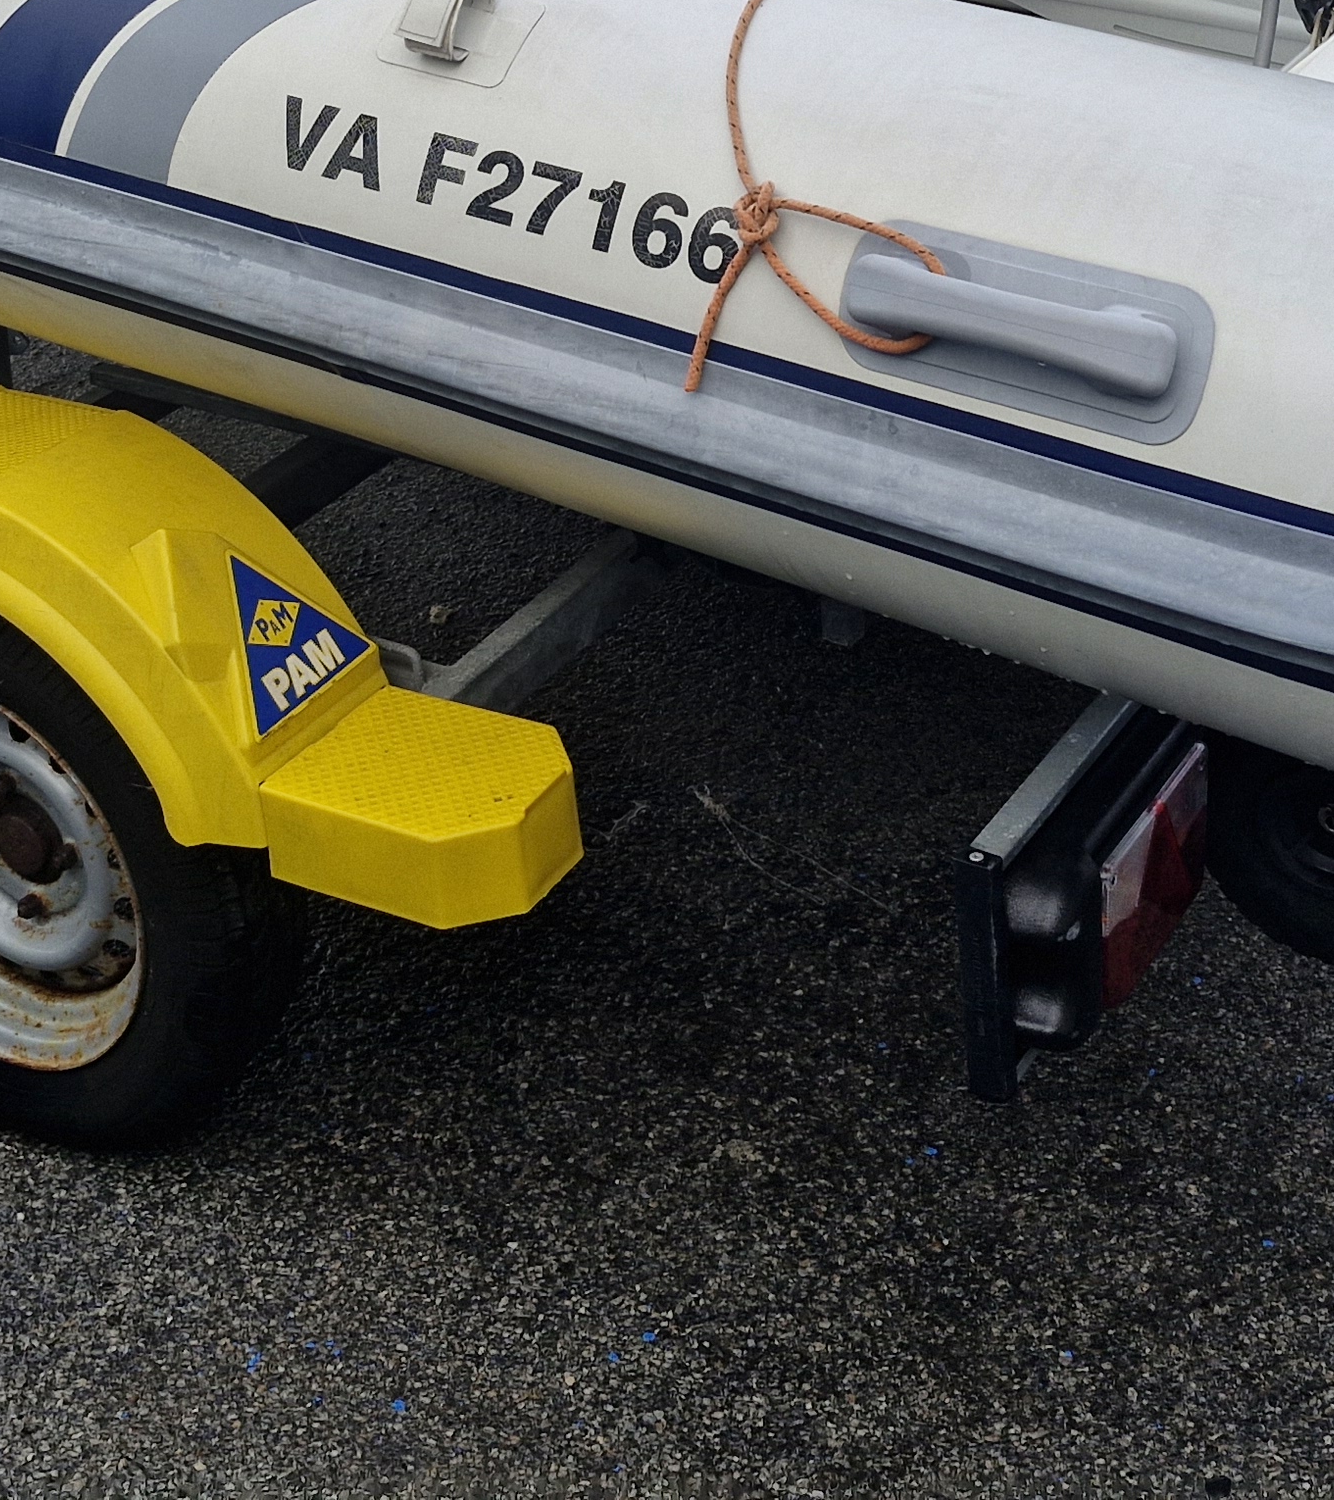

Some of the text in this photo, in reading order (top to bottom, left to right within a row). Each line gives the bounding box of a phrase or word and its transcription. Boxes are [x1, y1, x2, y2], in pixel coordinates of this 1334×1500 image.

[283, 94, 740, 285] VA F27166
[261, 628, 346, 712] PAM
